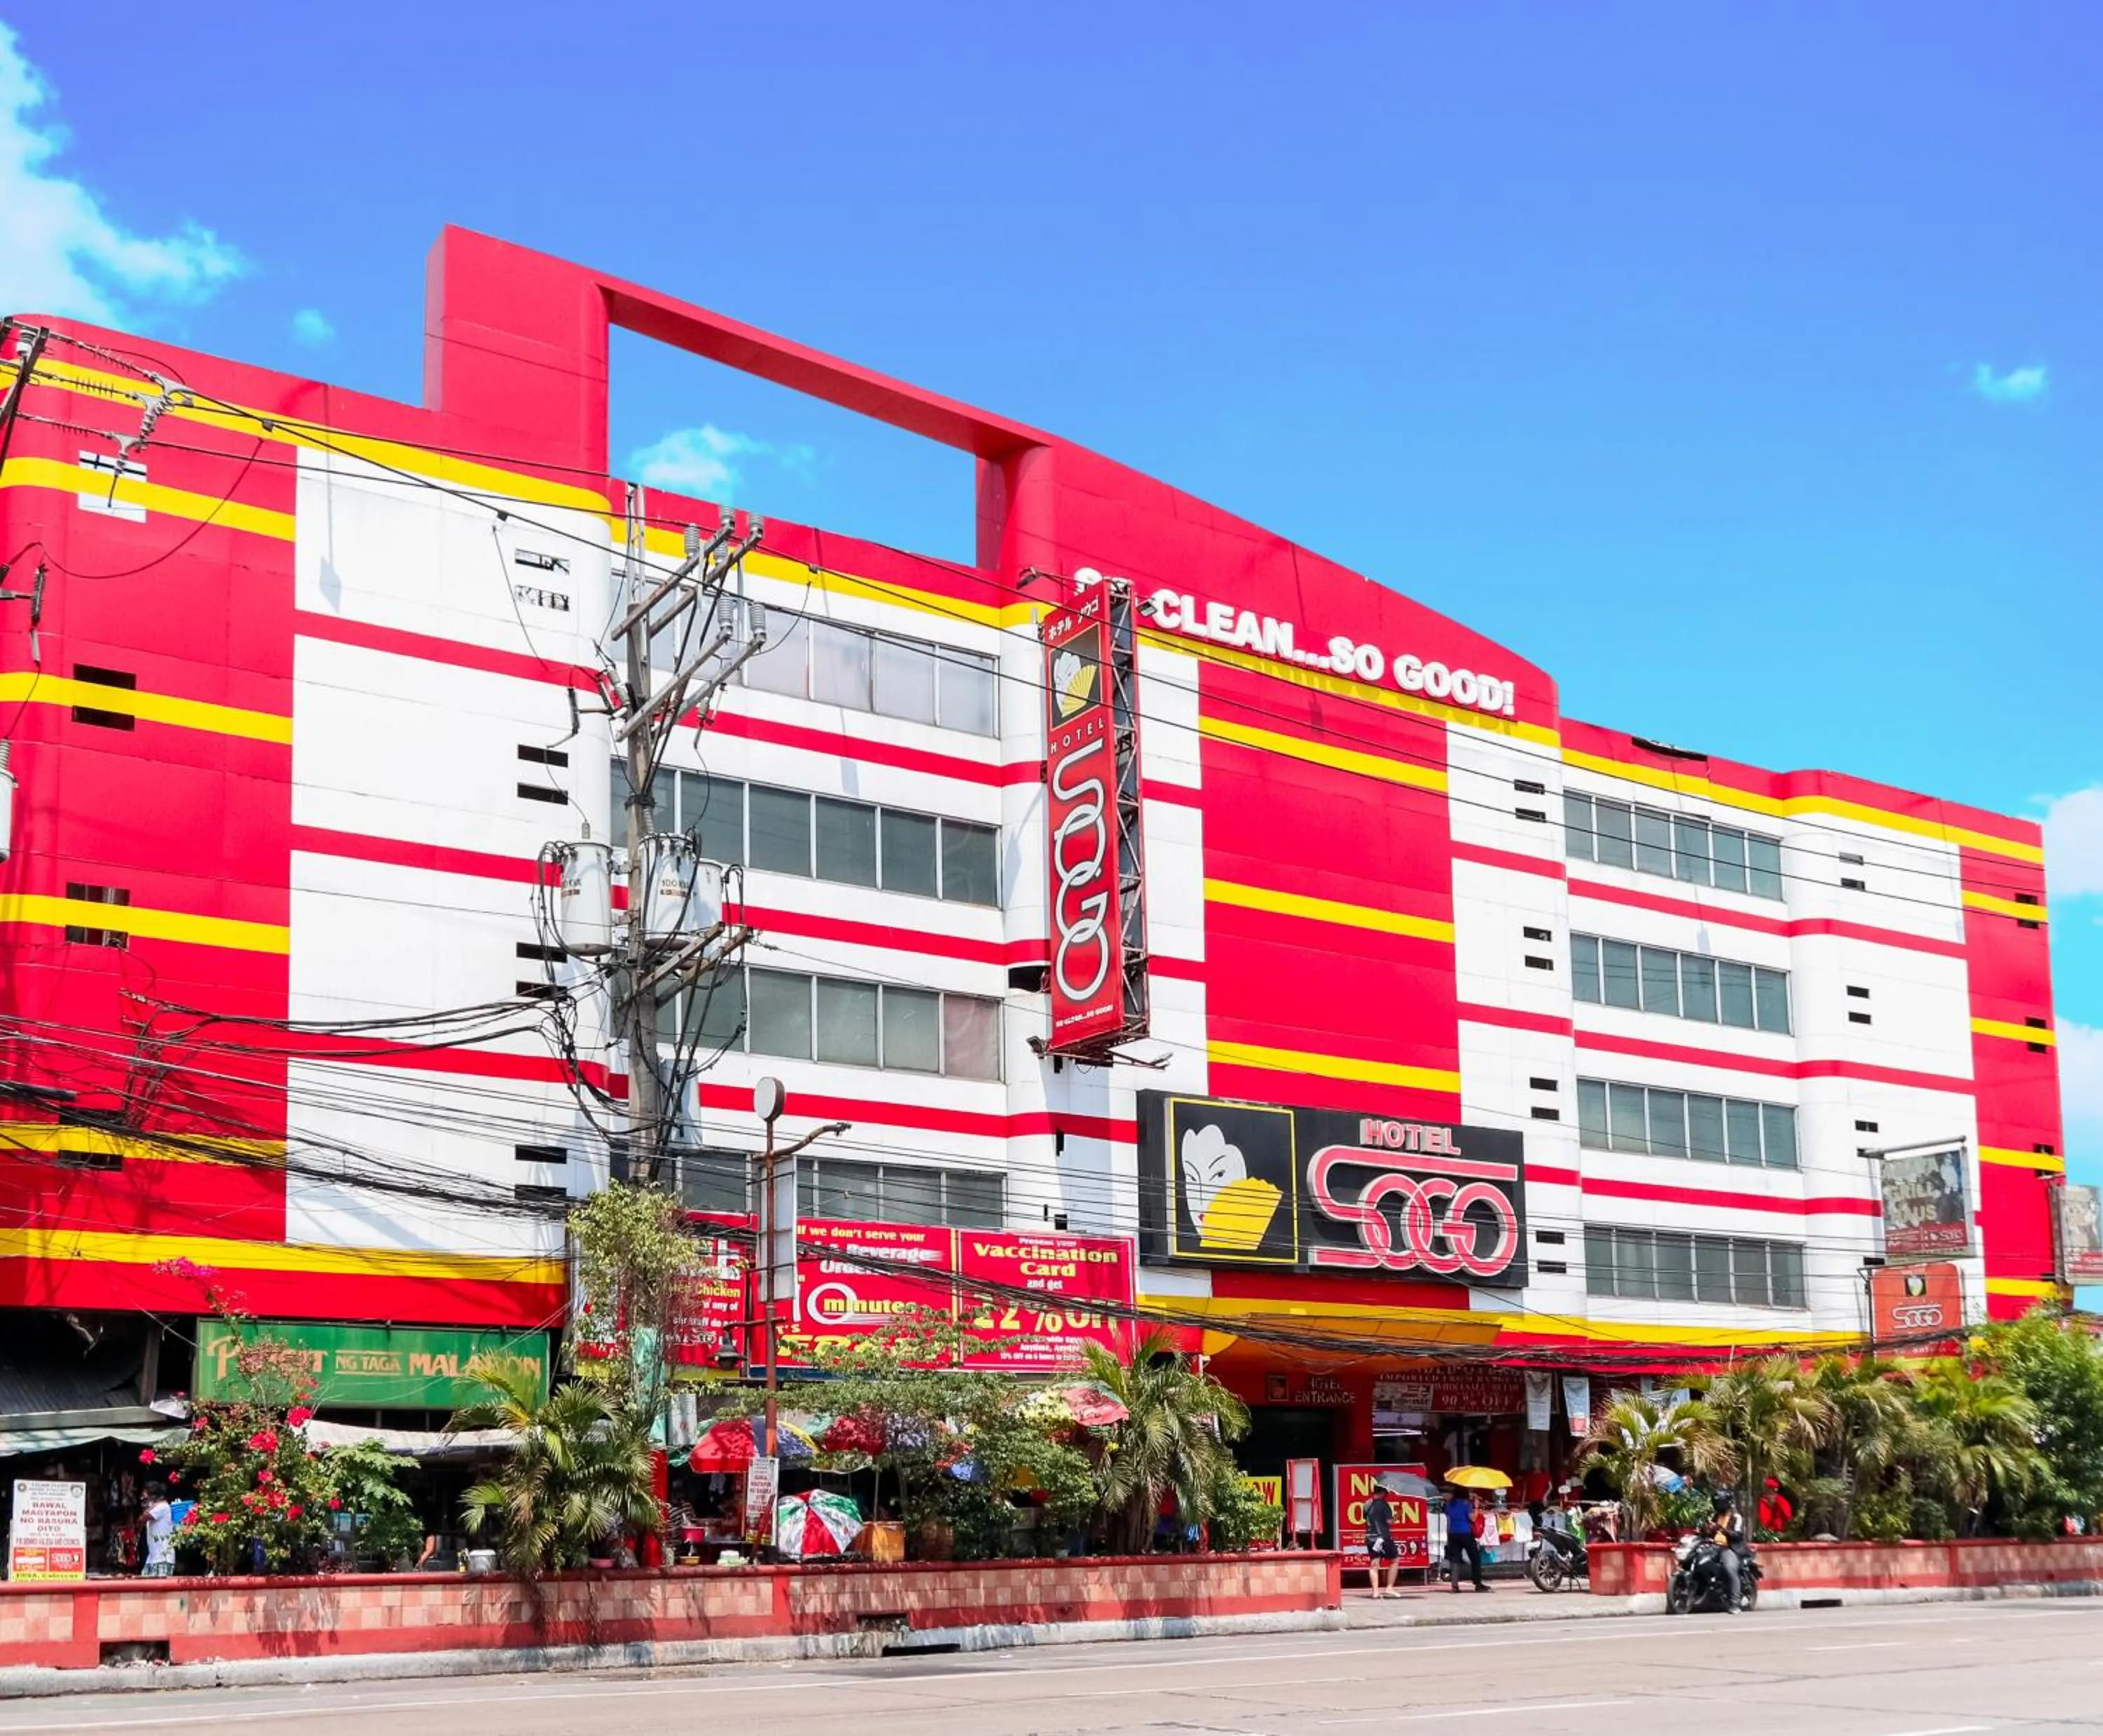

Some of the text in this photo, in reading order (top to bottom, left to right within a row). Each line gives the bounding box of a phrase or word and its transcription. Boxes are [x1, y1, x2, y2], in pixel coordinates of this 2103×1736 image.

[1393, 653, 1516, 717] GOOD!
[1051, 717, 1105, 755] HOTEL
[1052, 738, 1110, 1001] SOGO
[1360, 1118, 1461, 1156] HOTEL
[1307, 1144, 1518, 1277] SOGO
[797, 1225, 926, 1242] If we don't serve your
[1020, 1261, 1077, 1277] Card
[1026, 1279, 1064, 1291] and get
[712, 1301, 727, 1312] any
[1892, 1304, 1943, 1329] SOGO
[775, 1322, 801, 1334] T'S
[334, 1354, 357, 1371] NG
[362, 1355, 401, 1372] TAGA
[1295, 1390, 1357, 1404] ENTRANCE
[1347, 1501, 1420, 1525] OEN
